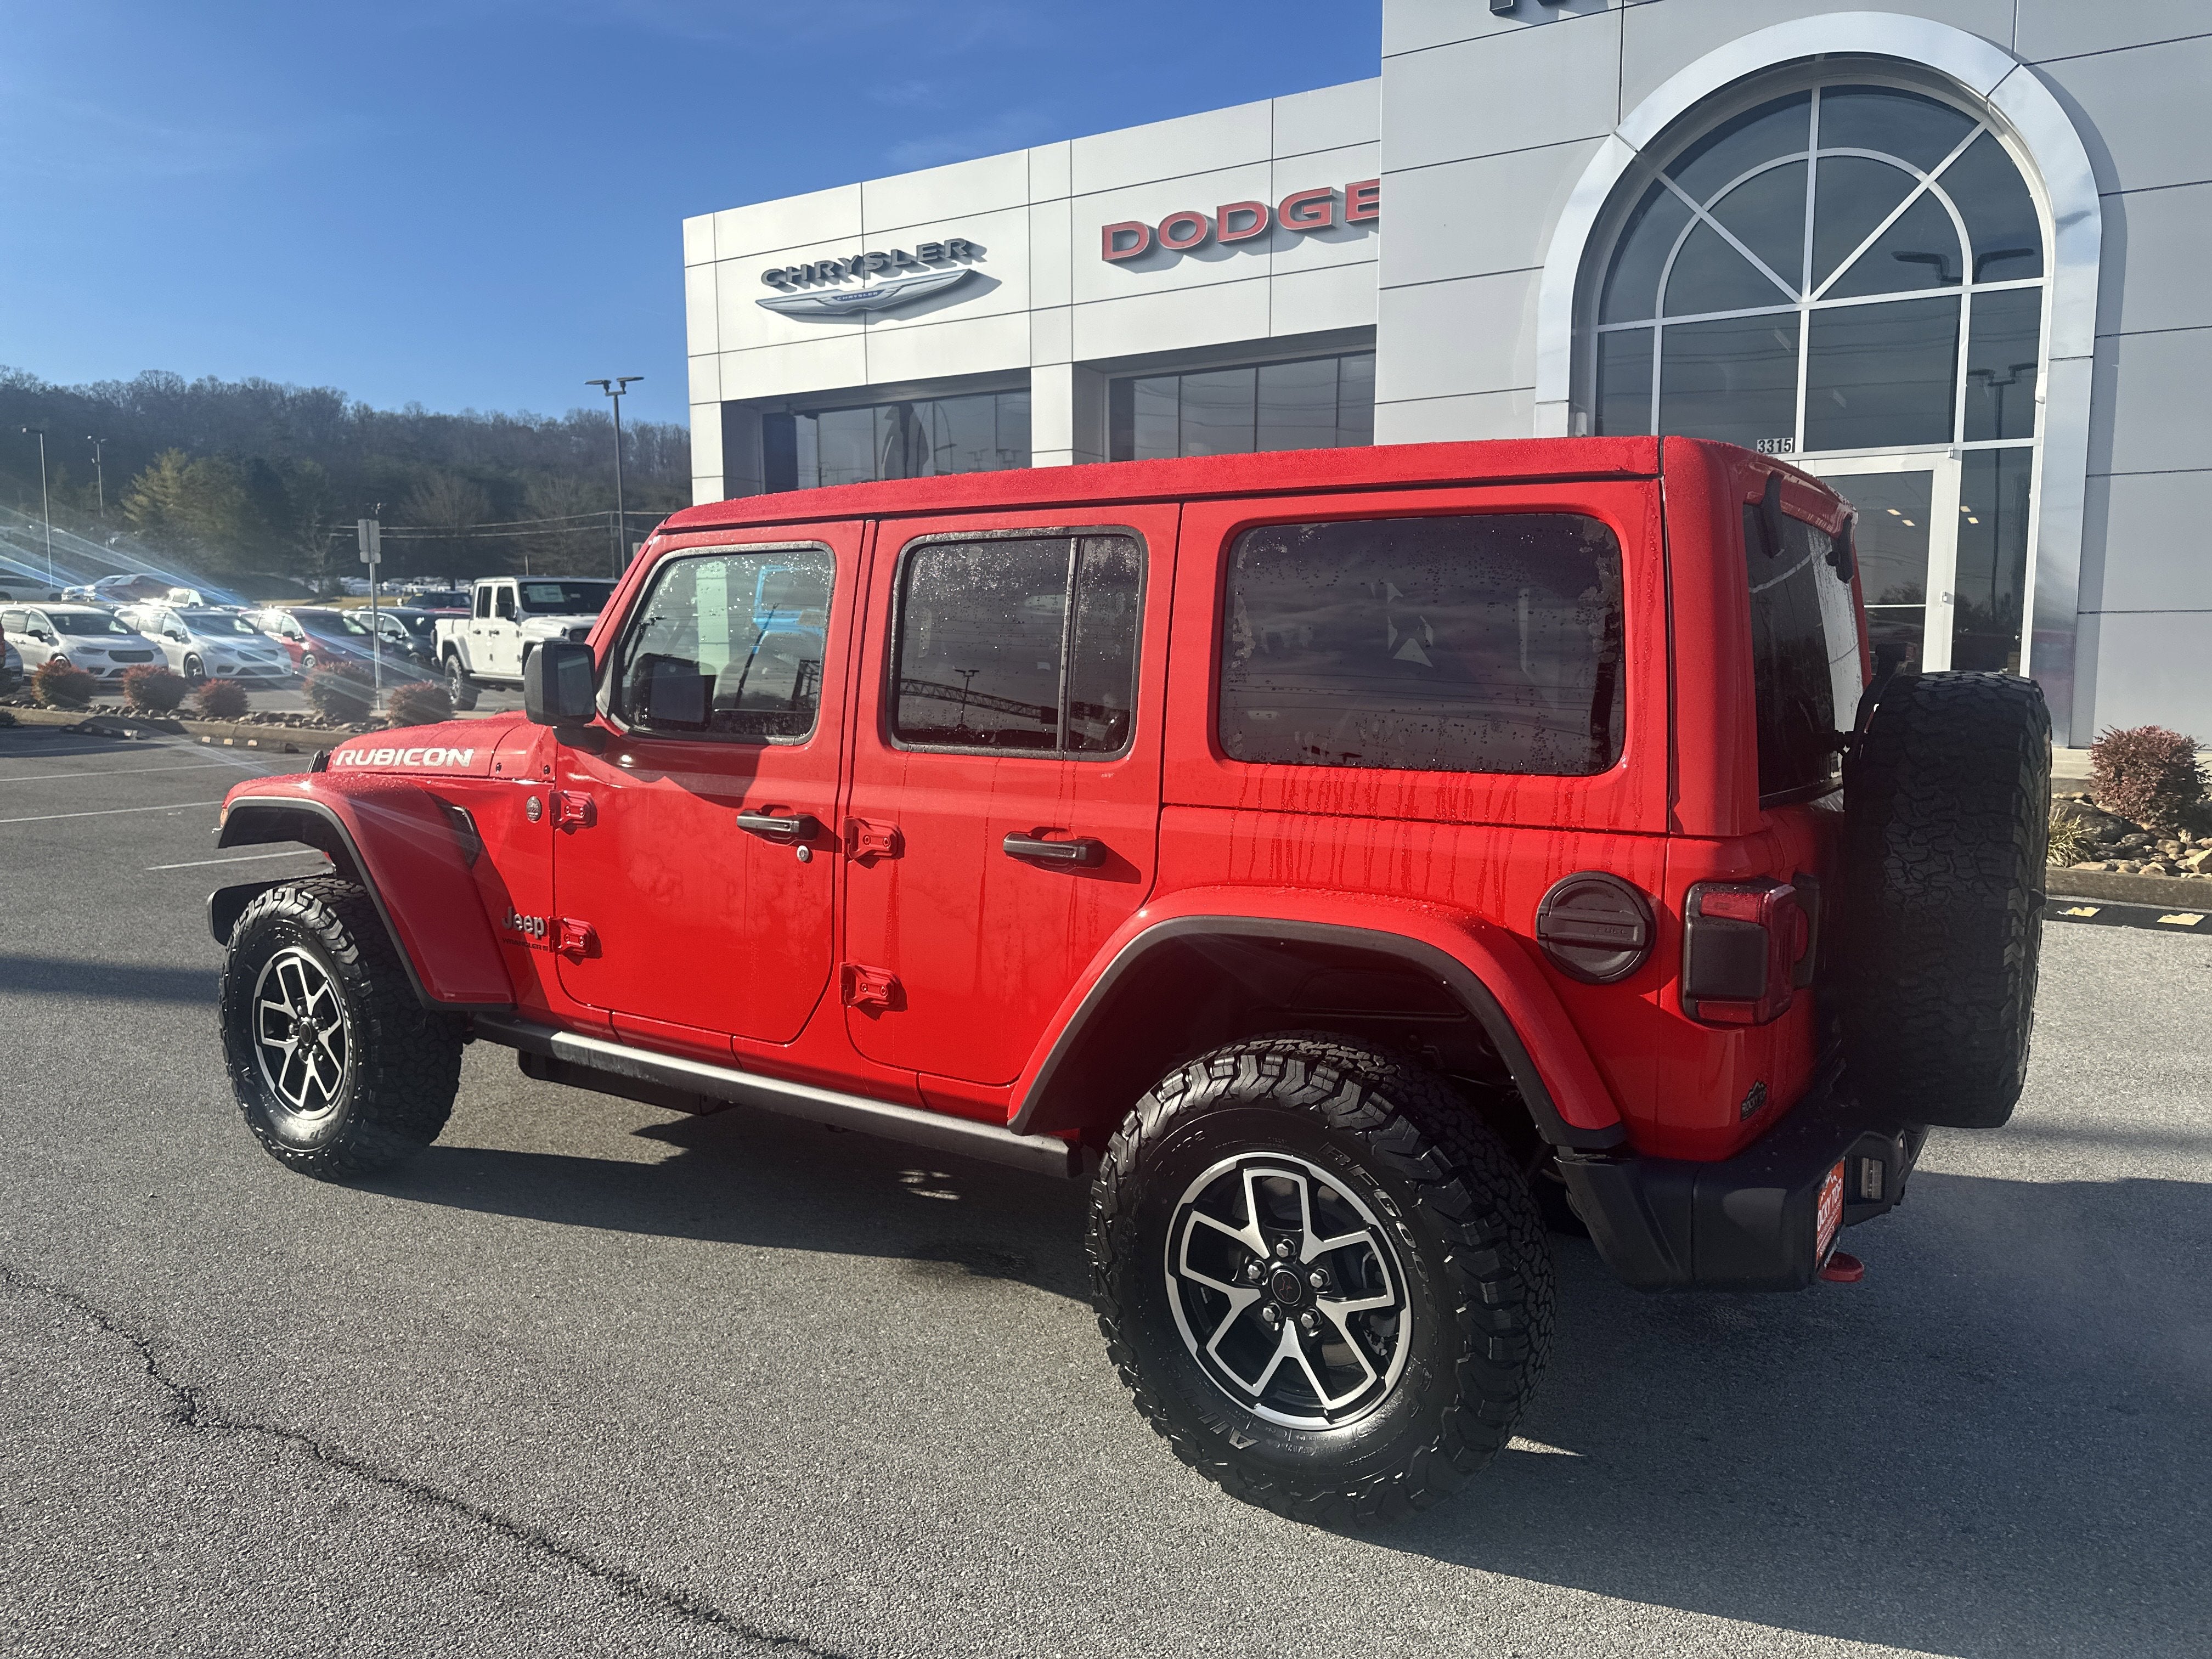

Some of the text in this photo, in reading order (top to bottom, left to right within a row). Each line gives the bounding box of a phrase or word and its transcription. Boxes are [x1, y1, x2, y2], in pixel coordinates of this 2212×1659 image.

[1102, 178, 1380, 261] DODGE
[761, 238, 969, 287] CHRYSLER
[837, 291, 878, 301] CHRYSLER
[1758, 438, 1791, 453] 3315
[335, 748, 474, 767] RUBICON
[501, 906, 544, 939] Jeep
[503, 937, 541, 950] WRANGLER
